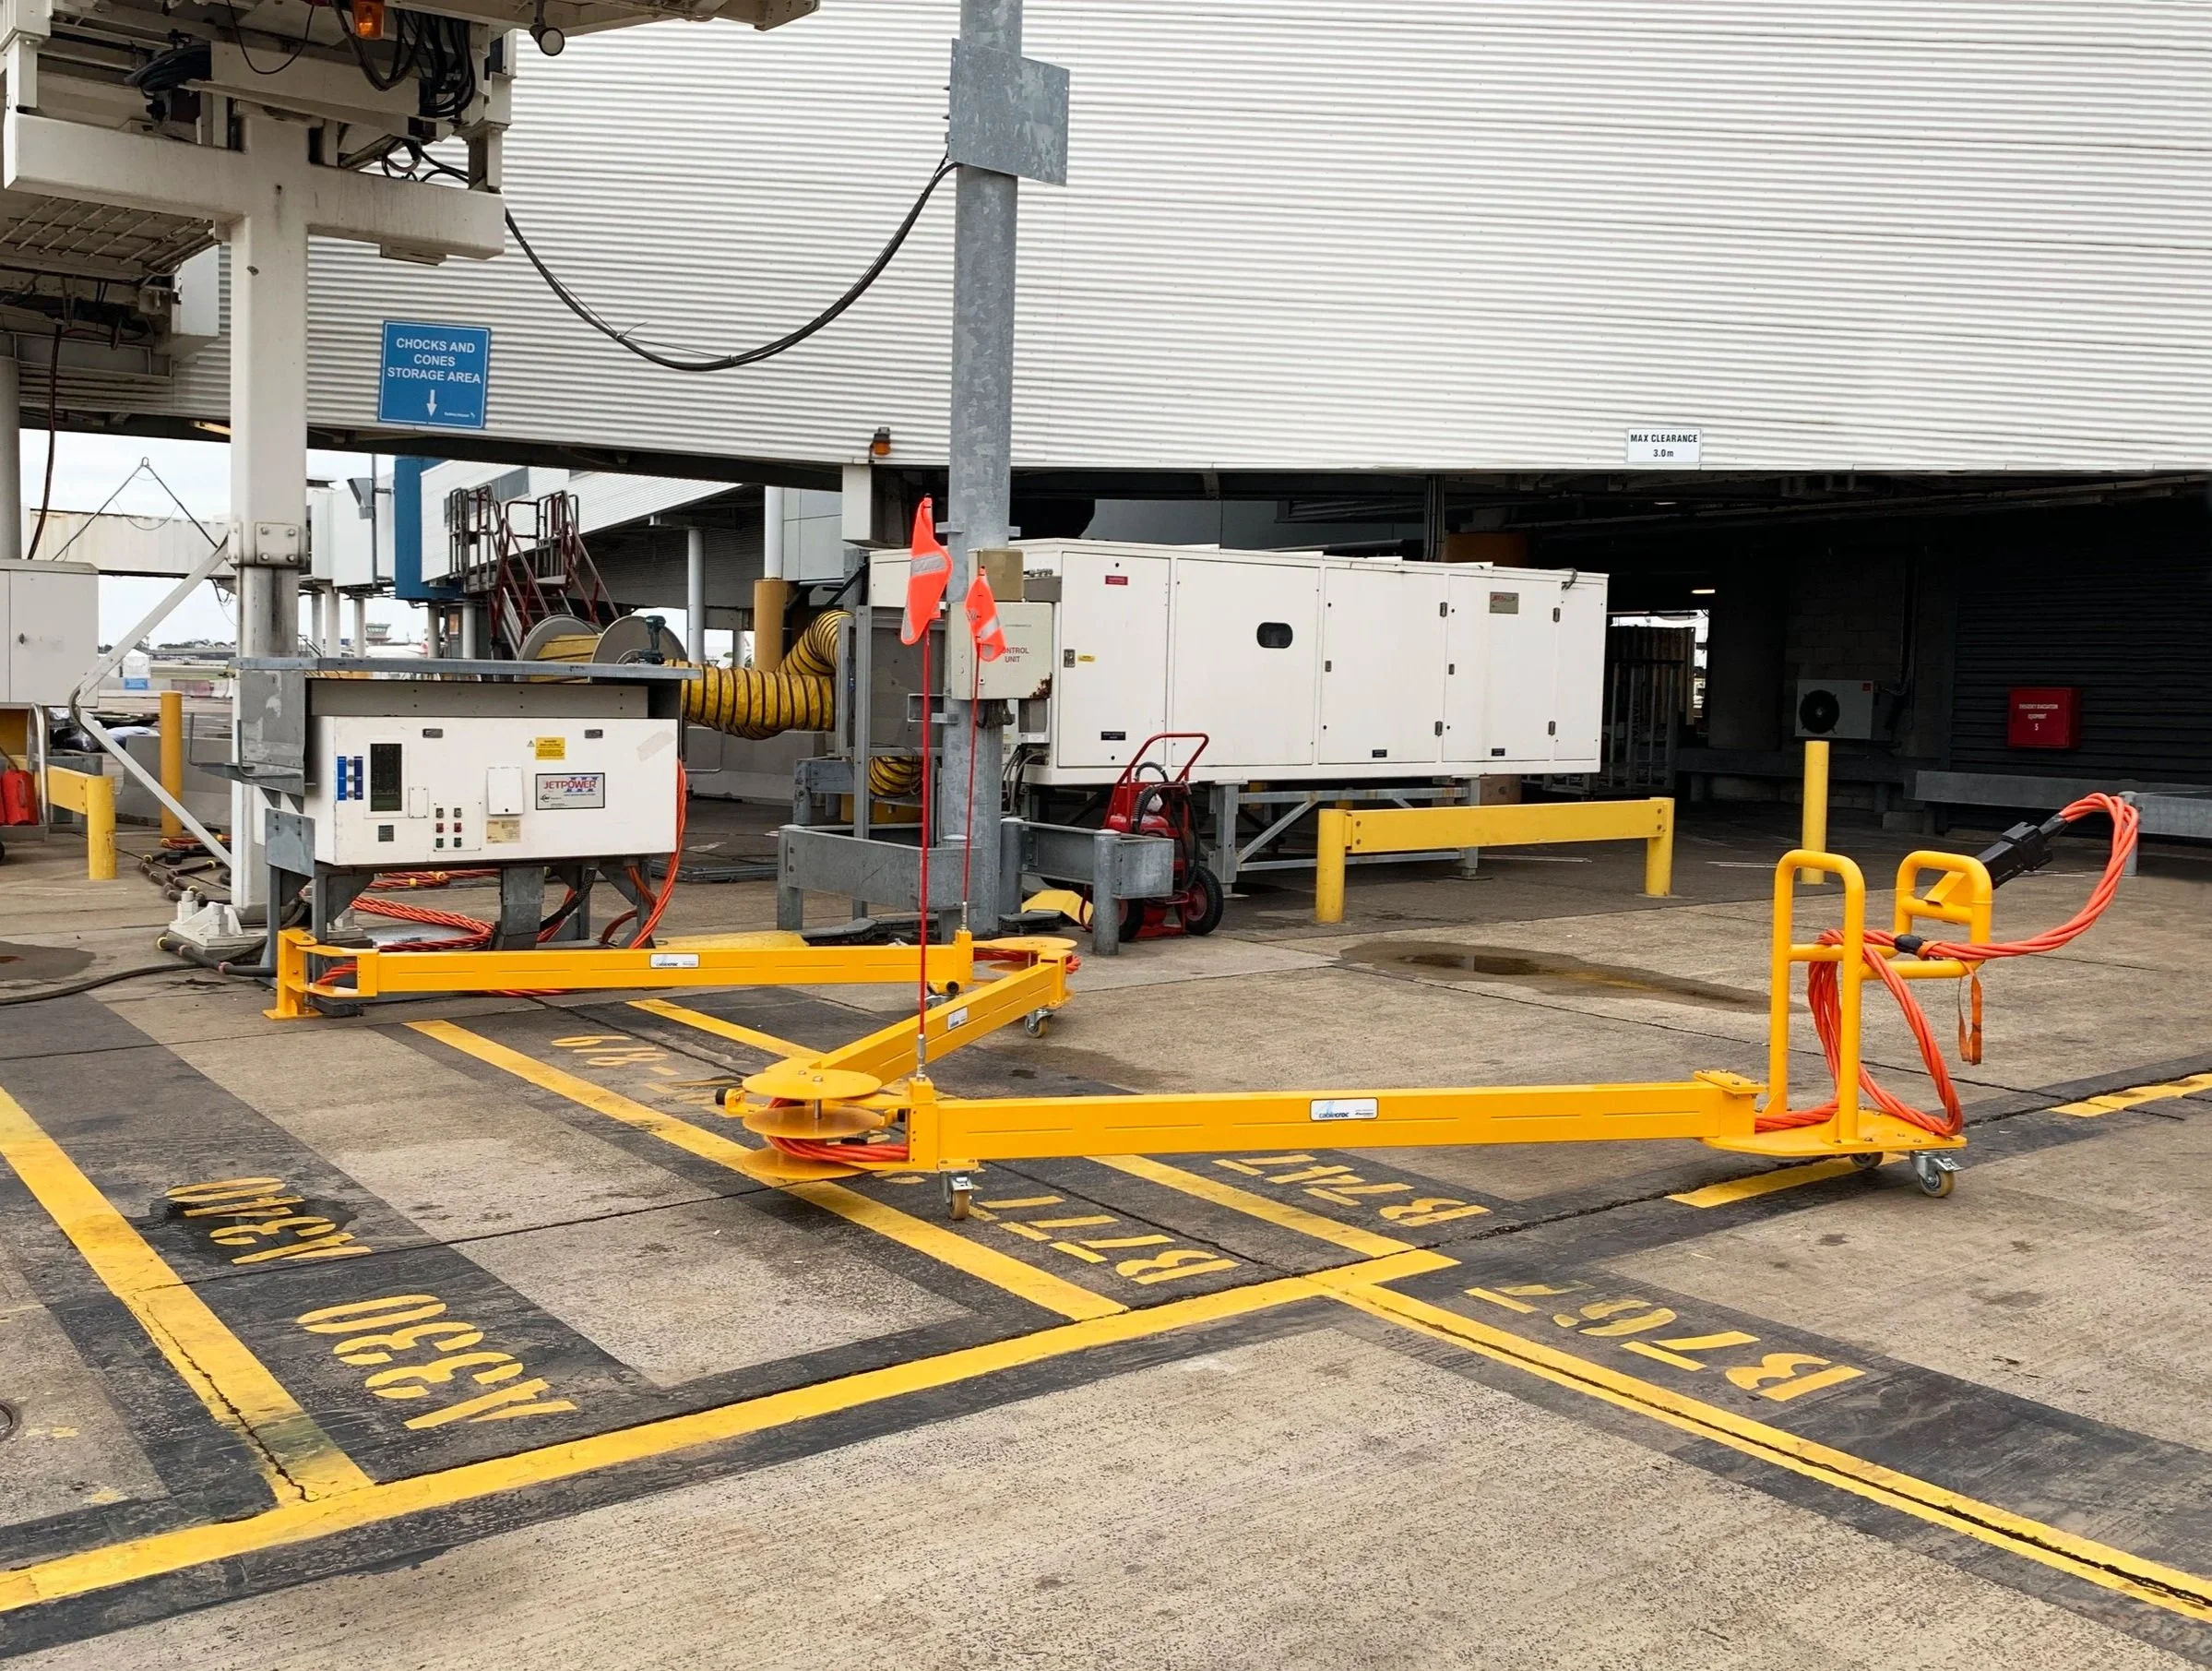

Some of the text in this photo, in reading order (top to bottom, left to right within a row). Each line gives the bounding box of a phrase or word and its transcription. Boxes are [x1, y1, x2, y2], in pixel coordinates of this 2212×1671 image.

[396, 338, 475, 353] CHOCKS AND
[413, 353, 456, 366] CONES
[387, 366, 482, 384] STORAGE AREA
[1630, 434, 1698, 443] MAX CLEARANCE
[543, 780, 597, 790] JETPOWER
[165, 1176, 372, 1265] A340
[1464, 1279, 1867, 1402] B767
[296, 1294, 578, 1430] A330
